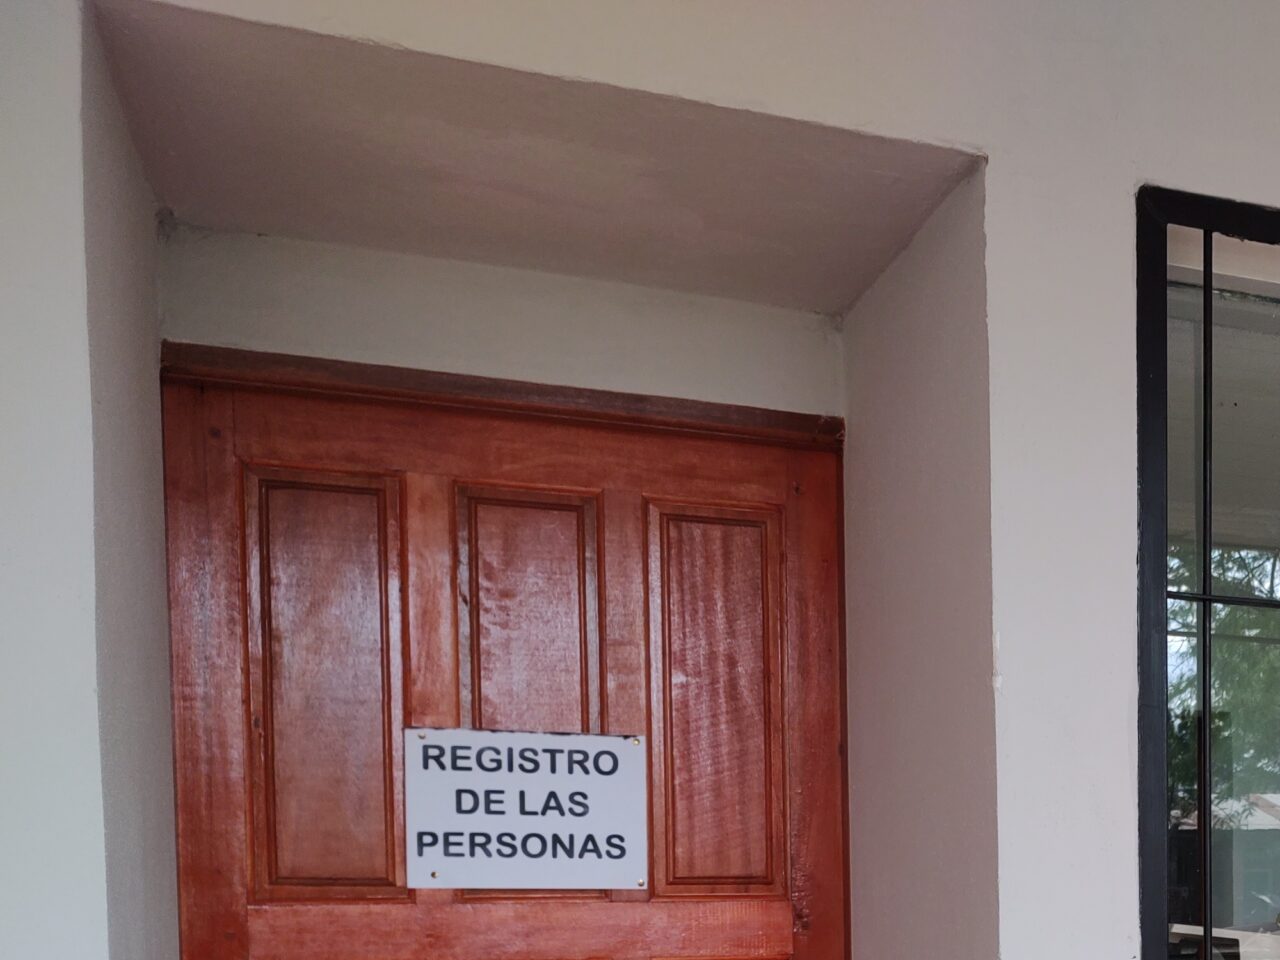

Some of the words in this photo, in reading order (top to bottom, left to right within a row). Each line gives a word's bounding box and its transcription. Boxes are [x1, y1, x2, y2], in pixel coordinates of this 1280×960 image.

[421, 744, 619, 776] REGISTRO
[455, 788, 506, 815] DE
[519, 789, 590, 817] LAS
[416, 831, 627, 860] PERSONAS
